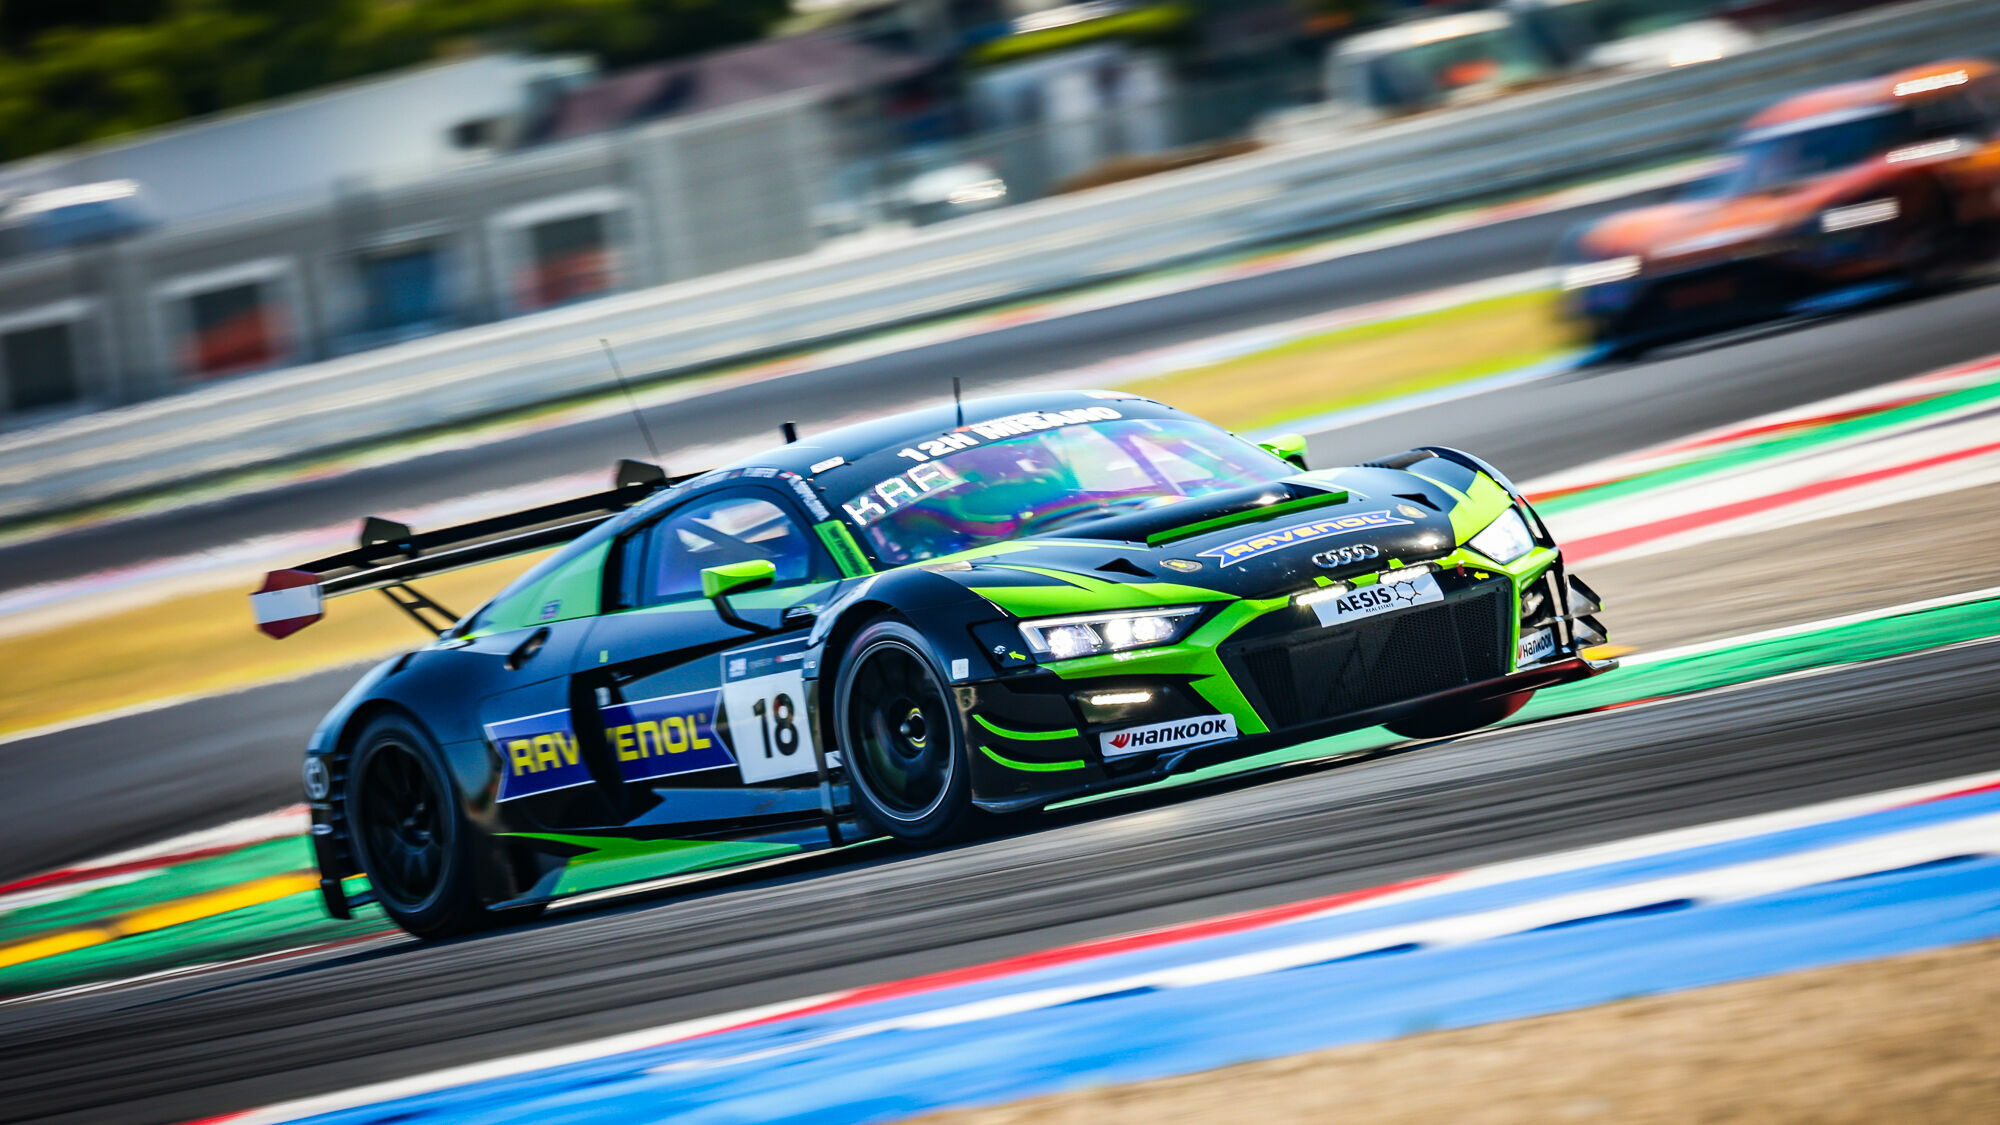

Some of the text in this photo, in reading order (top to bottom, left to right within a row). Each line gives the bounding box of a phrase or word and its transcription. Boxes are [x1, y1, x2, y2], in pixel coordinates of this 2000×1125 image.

[897, 406, 1123, 462] 12H MISANO
[1336, 587, 1392, 615] AESIS
[753, 692, 799, 759] 18
